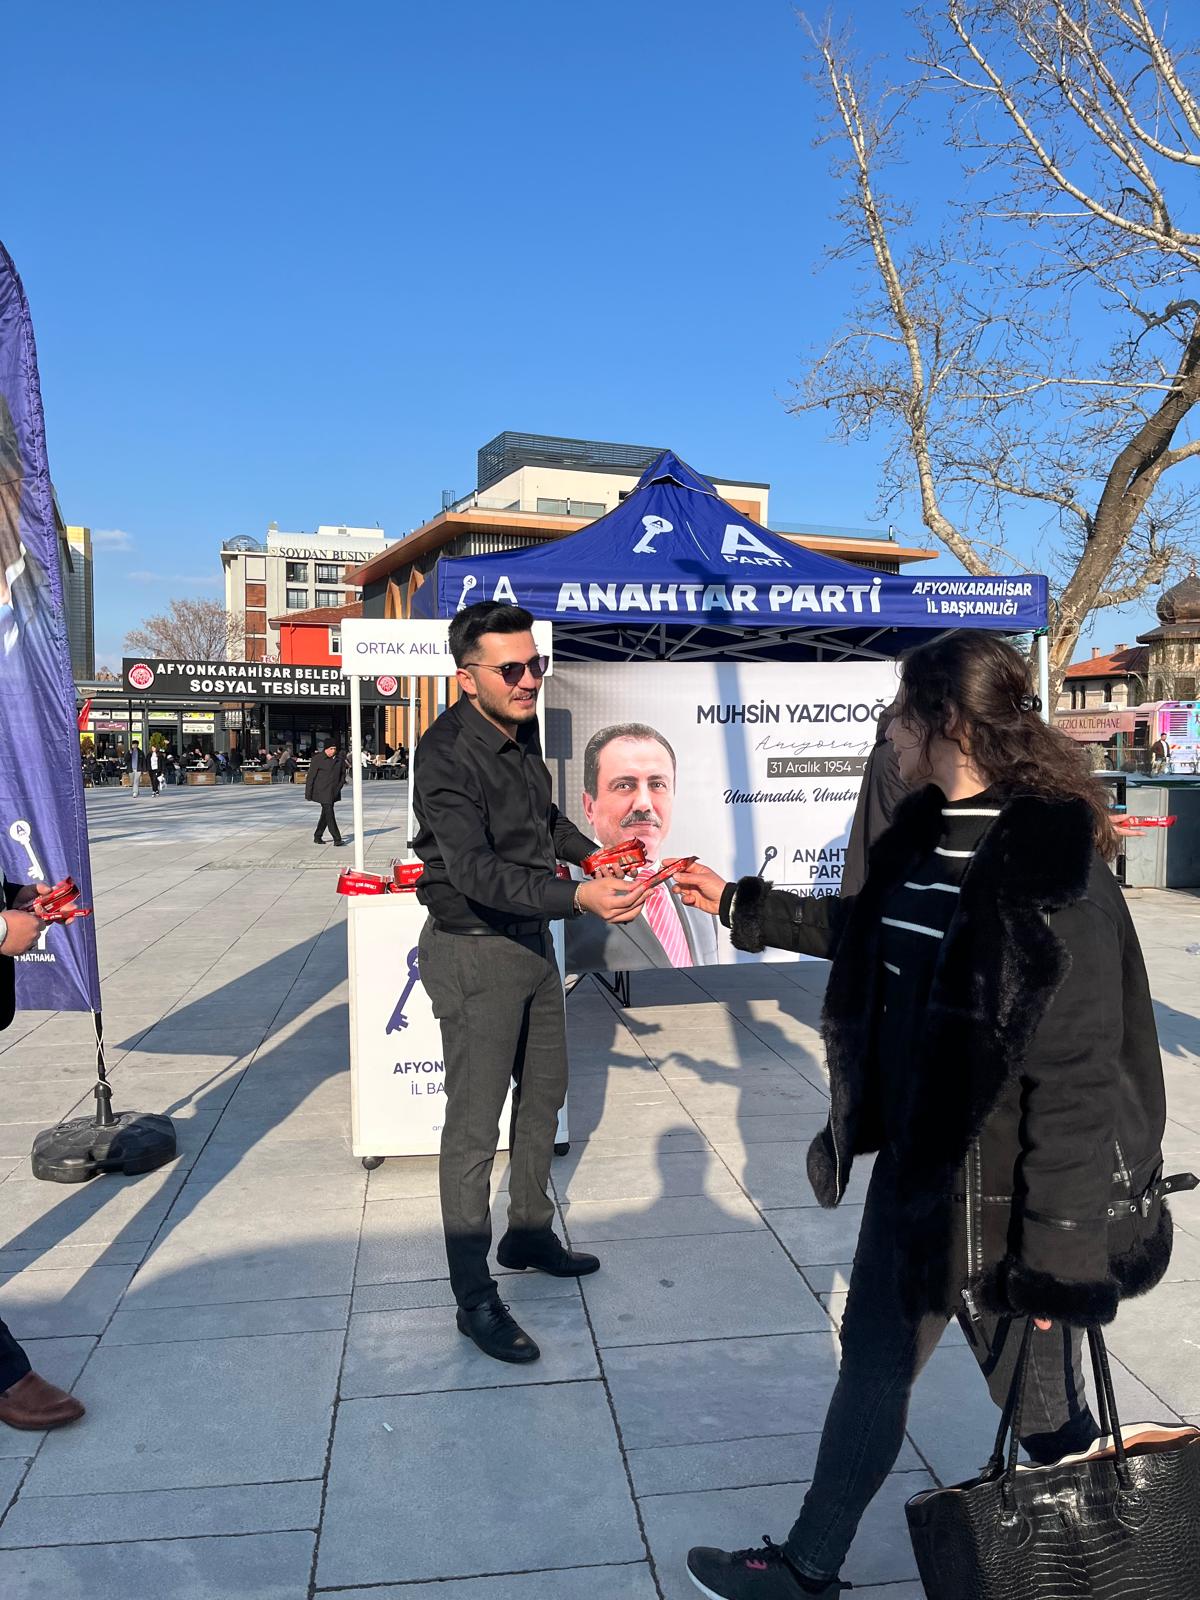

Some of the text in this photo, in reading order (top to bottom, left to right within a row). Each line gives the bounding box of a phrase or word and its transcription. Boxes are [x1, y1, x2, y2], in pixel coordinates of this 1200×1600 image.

[721, 524, 784, 560] A
[279, 547, 379, 561] SOYDAN BUSINE
[492, 576, 518, 603] A
[556, 577, 882, 613] ANAHTAR PARTİ
[912, 579, 1032, 596] AFYONKARAHİSAR
[926, 598, 1018, 617] İL BAŞKANLIĞI
[356, 642, 405, 655] ORTAK
[409, 642, 440, 655] AKIL
[156, 663, 291, 679] AFYONKARAHİSAR
[190, 679, 346, 696] SOSYAL TESİSLERİ
[697, 699, 885, 724] MUHSİN YAZICIOĞ
[770, 761, 782, 774] 31
[786, 760, 820, 773] Aralık
[824, 760, 851, 772] 1954
[723, 788, 860, 804] Unutmadık, Unutm
[792, 848, 848, 862] ANAHT
[809, 865, 846, 878] PAR
[393, 1060, 444, 1074] AFYON
[411, 1081, 445, 1095] İL BA
